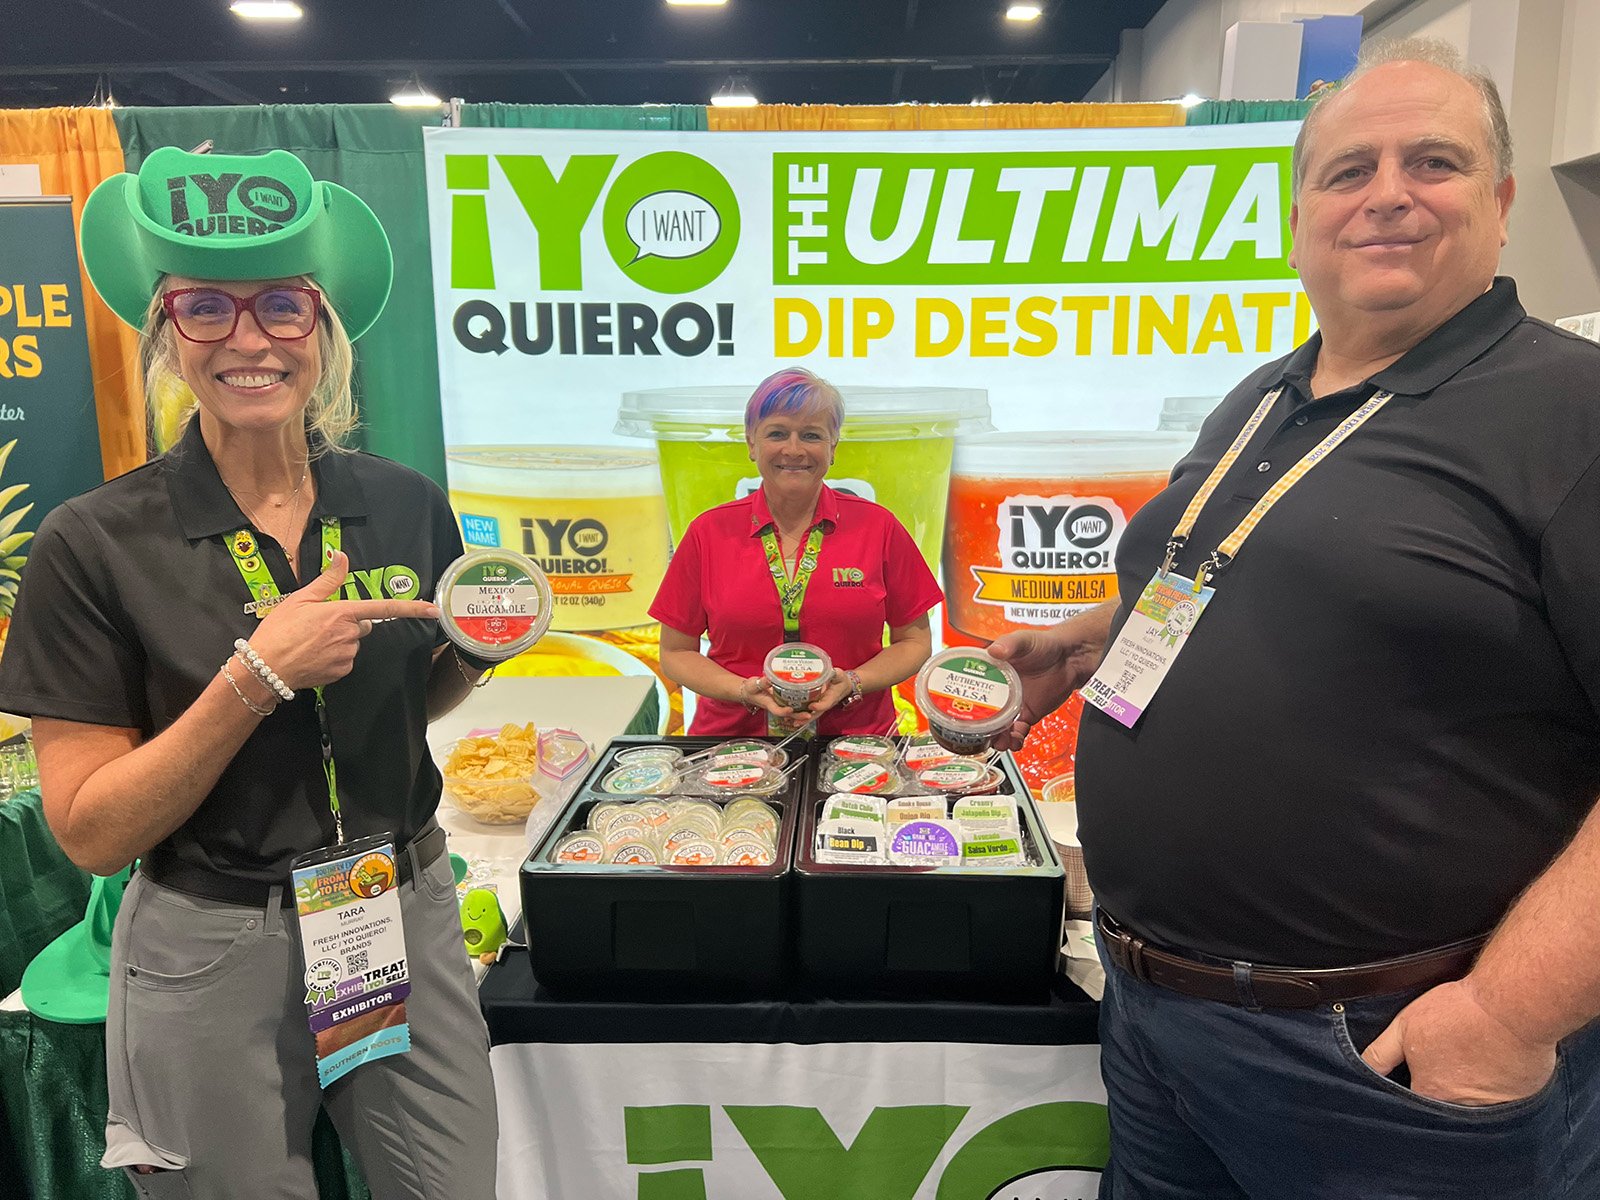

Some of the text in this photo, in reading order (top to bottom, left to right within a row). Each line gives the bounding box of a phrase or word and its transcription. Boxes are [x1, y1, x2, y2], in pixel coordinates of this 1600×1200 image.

[260, 193, 284, 208] WANT
[787, 163, 829, 275] THE
[843, 163, 1283, 265] ULTIMA
[641, 216, 707, 242] I WANT
[453, 300, 735, 358] QUIERO!
[774, 291, 1320, 358] DIP DESTINATI
[1356, 391, 1391, 419] OUTHERN
[1323, 418, 1359, 449] EXPOSURE
[465, 518, 493, 532] NEW
[1080, 521, 1103, 533] WANT
[467, 530, 498, 546] NAME
[582, 533, 599, 543] WANT
[528, 558, 607, 574] UIERO!
[1012, 551, 1109, 569] QUIERO!
[396, 578, 410, 590] WANT
[1011, 579, 1106, 600] MEDIUM SALSA
[246, 593, 291, 612] AVOCAD
[560, 596, 568, 605] 12
[569, 596, 580, 606] OZ
[1011, 607, 1026, 617] NET
[1026, 608, 1039, 618] WT
[1041, 609, 1049, 618] 15
[1050, 608, 1061, 619] OZ
[1146, 627, 1160, 637] JAY
[1120, 637, 1135, 649] FRESH
[1120, 647, 1130, 656] LLC
[1132, 652, 1139, 661] YO
[1124, 660, 1145, 674] BRANDS
[946, 673, 995, 691] AUTHENTIC
[1090, 678, 1117, 700] TREAT
[943, 685, 988, 703] SALSA
[1093, 695, 1108, 708] SELF
[829, 837, 865, 850] Bean Dip
[967, 844, 1008, 854] Salsa Verde
[318, 873, 344, 887] FROM
[320, 884, 333, 896] TO
[337, 906, 366, 920] TARA
[313, 917, 393, 947] FRESH INNOVATIONS,
[322, 943, 338, 953] LLC
[343, 937, 354, 946] YO
[357, 926, 387, 942] QUIERO!
[340, 940, 372, 956] BRANDS
[310, 961, 340, 974] CERTIFIED
[364, 959, 405, 982] TREAT
[386, 970, 407, 984] SELF
[332, 992, 393, 1021] EXHIBITOR
[324, 1036, 402, 1077] SOUTHERN ROOTS
